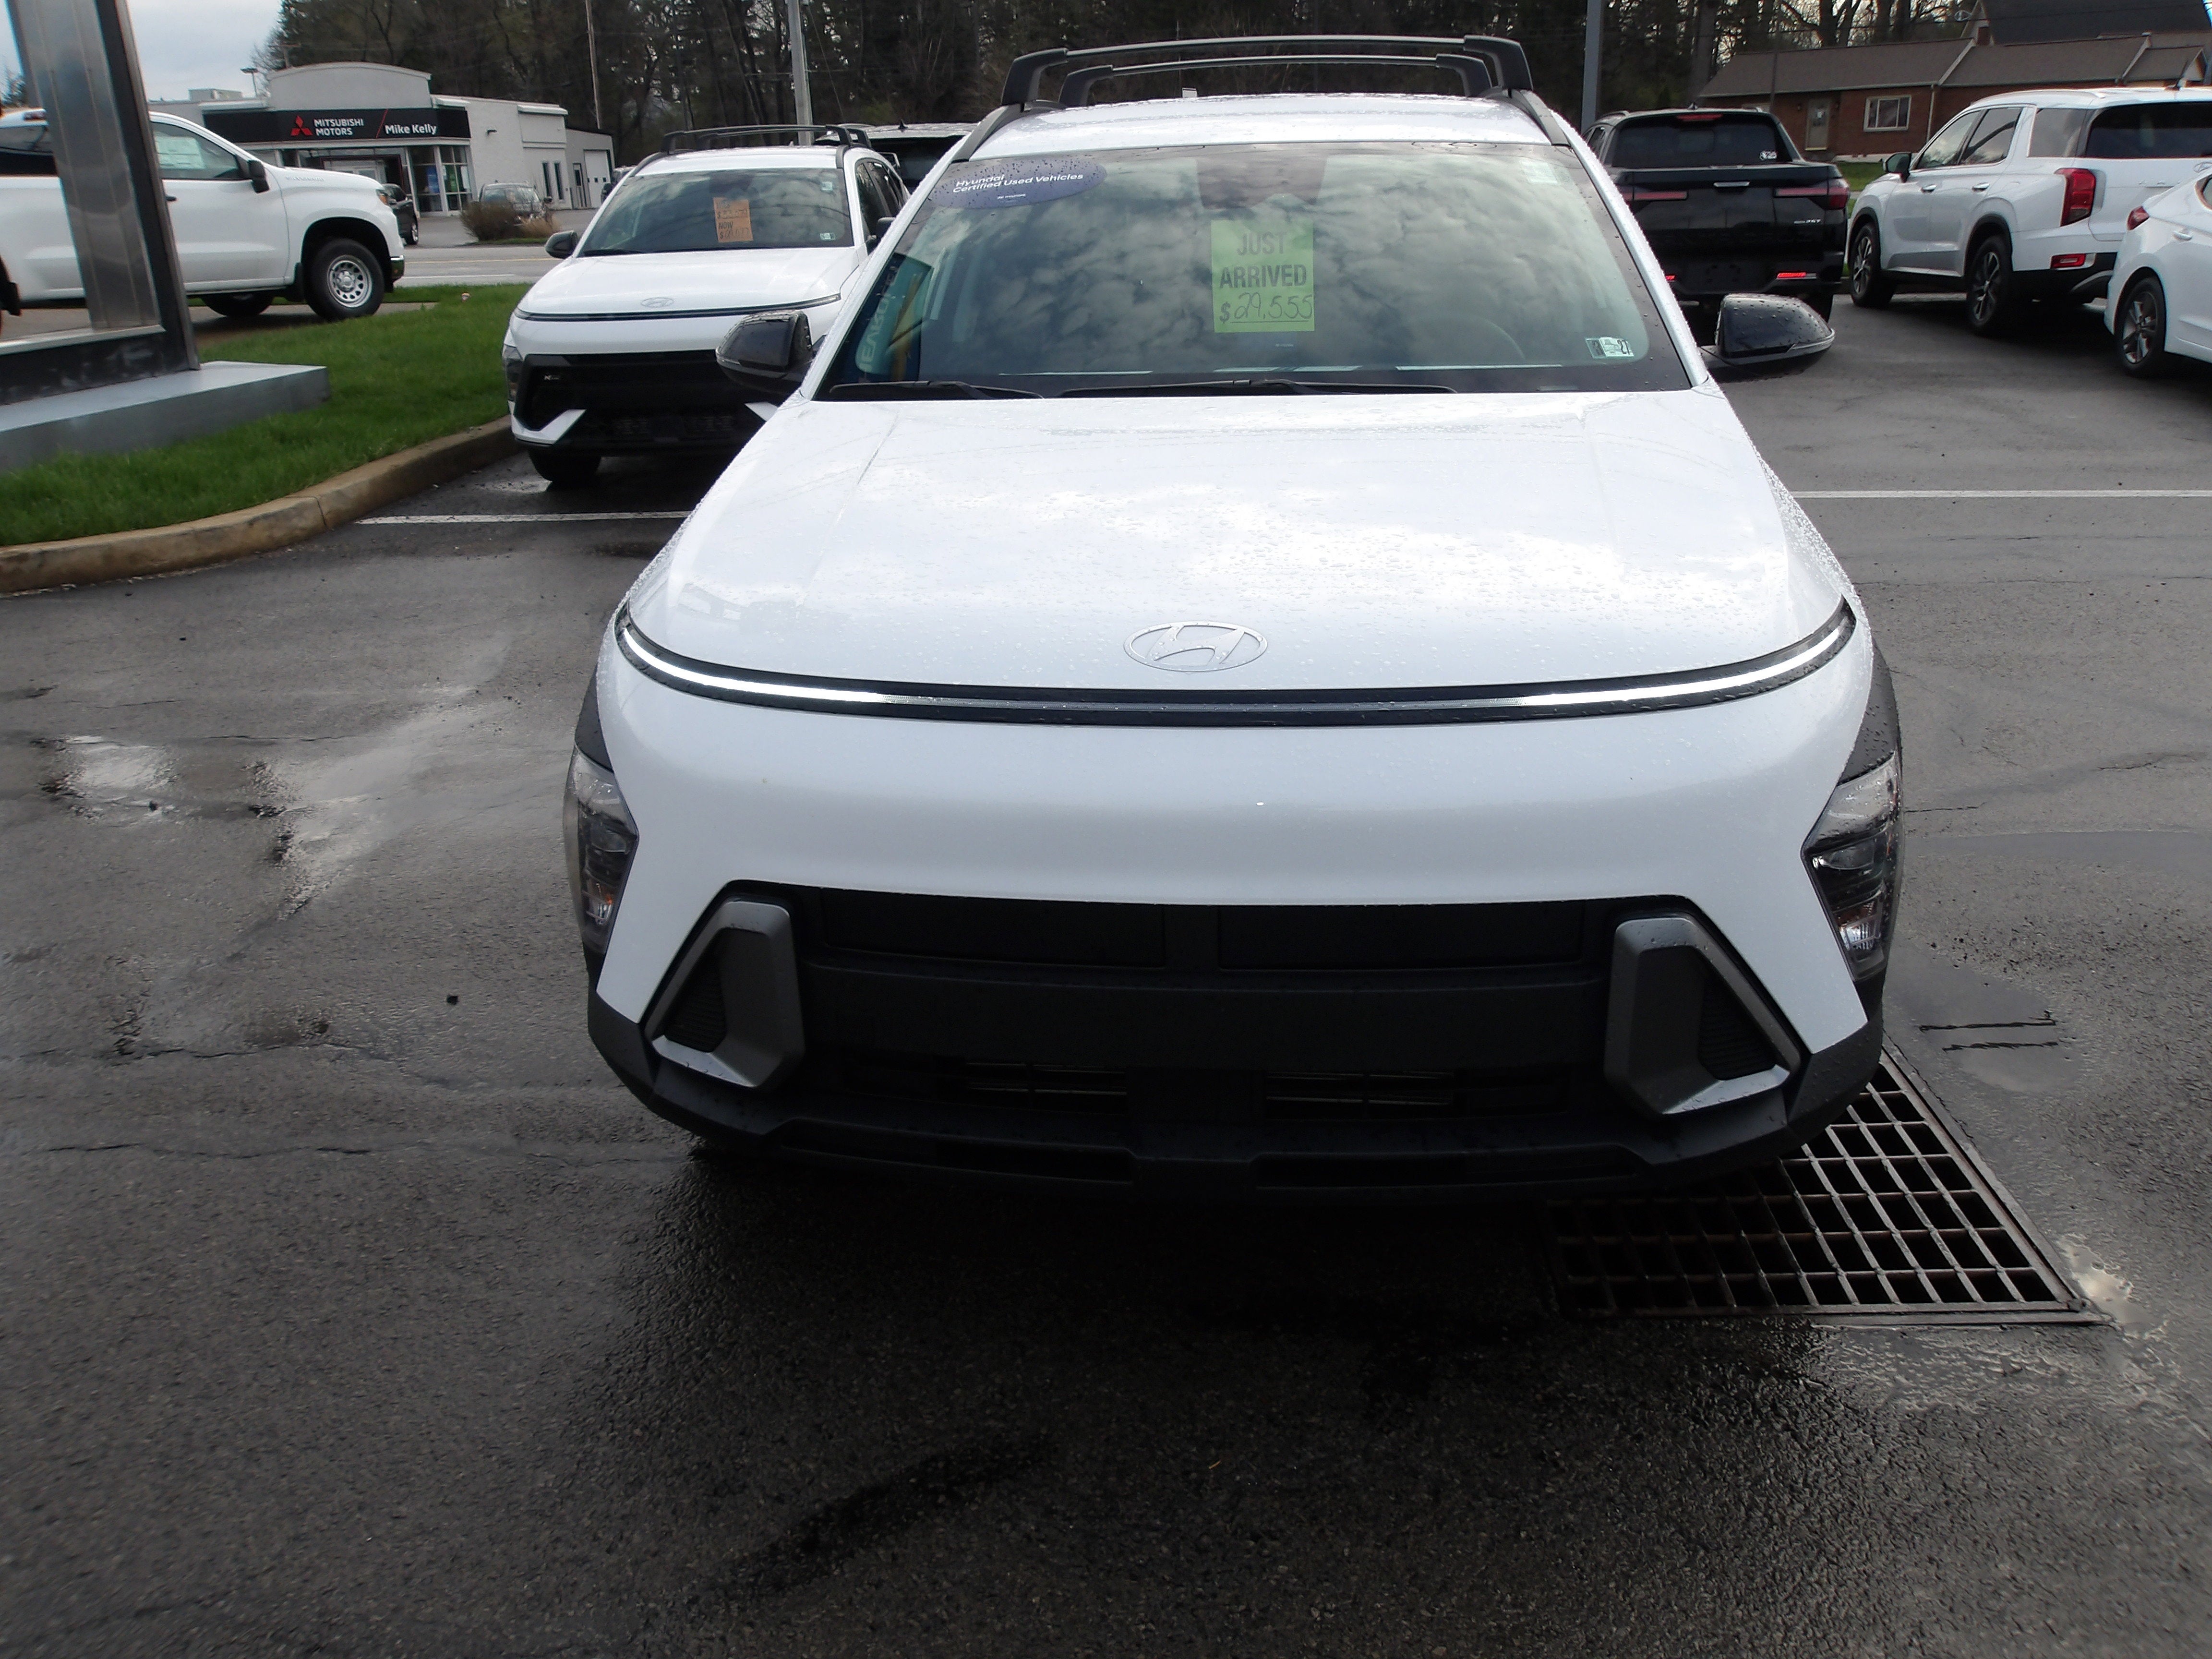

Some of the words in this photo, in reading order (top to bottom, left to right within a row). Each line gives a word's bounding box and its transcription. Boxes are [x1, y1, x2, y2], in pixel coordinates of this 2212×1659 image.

[313, 118, 364, 127] MITSUBISHI
[385, 124, 410, 135] Mike
[411, 123, 437, 135] Kelly
[315, 127, 353, 136] MOTORS
[953, 180, 1002, 193] Certified
[1004, 177, 1034, 186] Used
[1035, 174, 1083, 182] Vehicles
[956, 174, 1005, 187] Hyundai
[1237, 231, 1285, 255] JUST
[1219, 264, 1307, 288] ARRIVED
